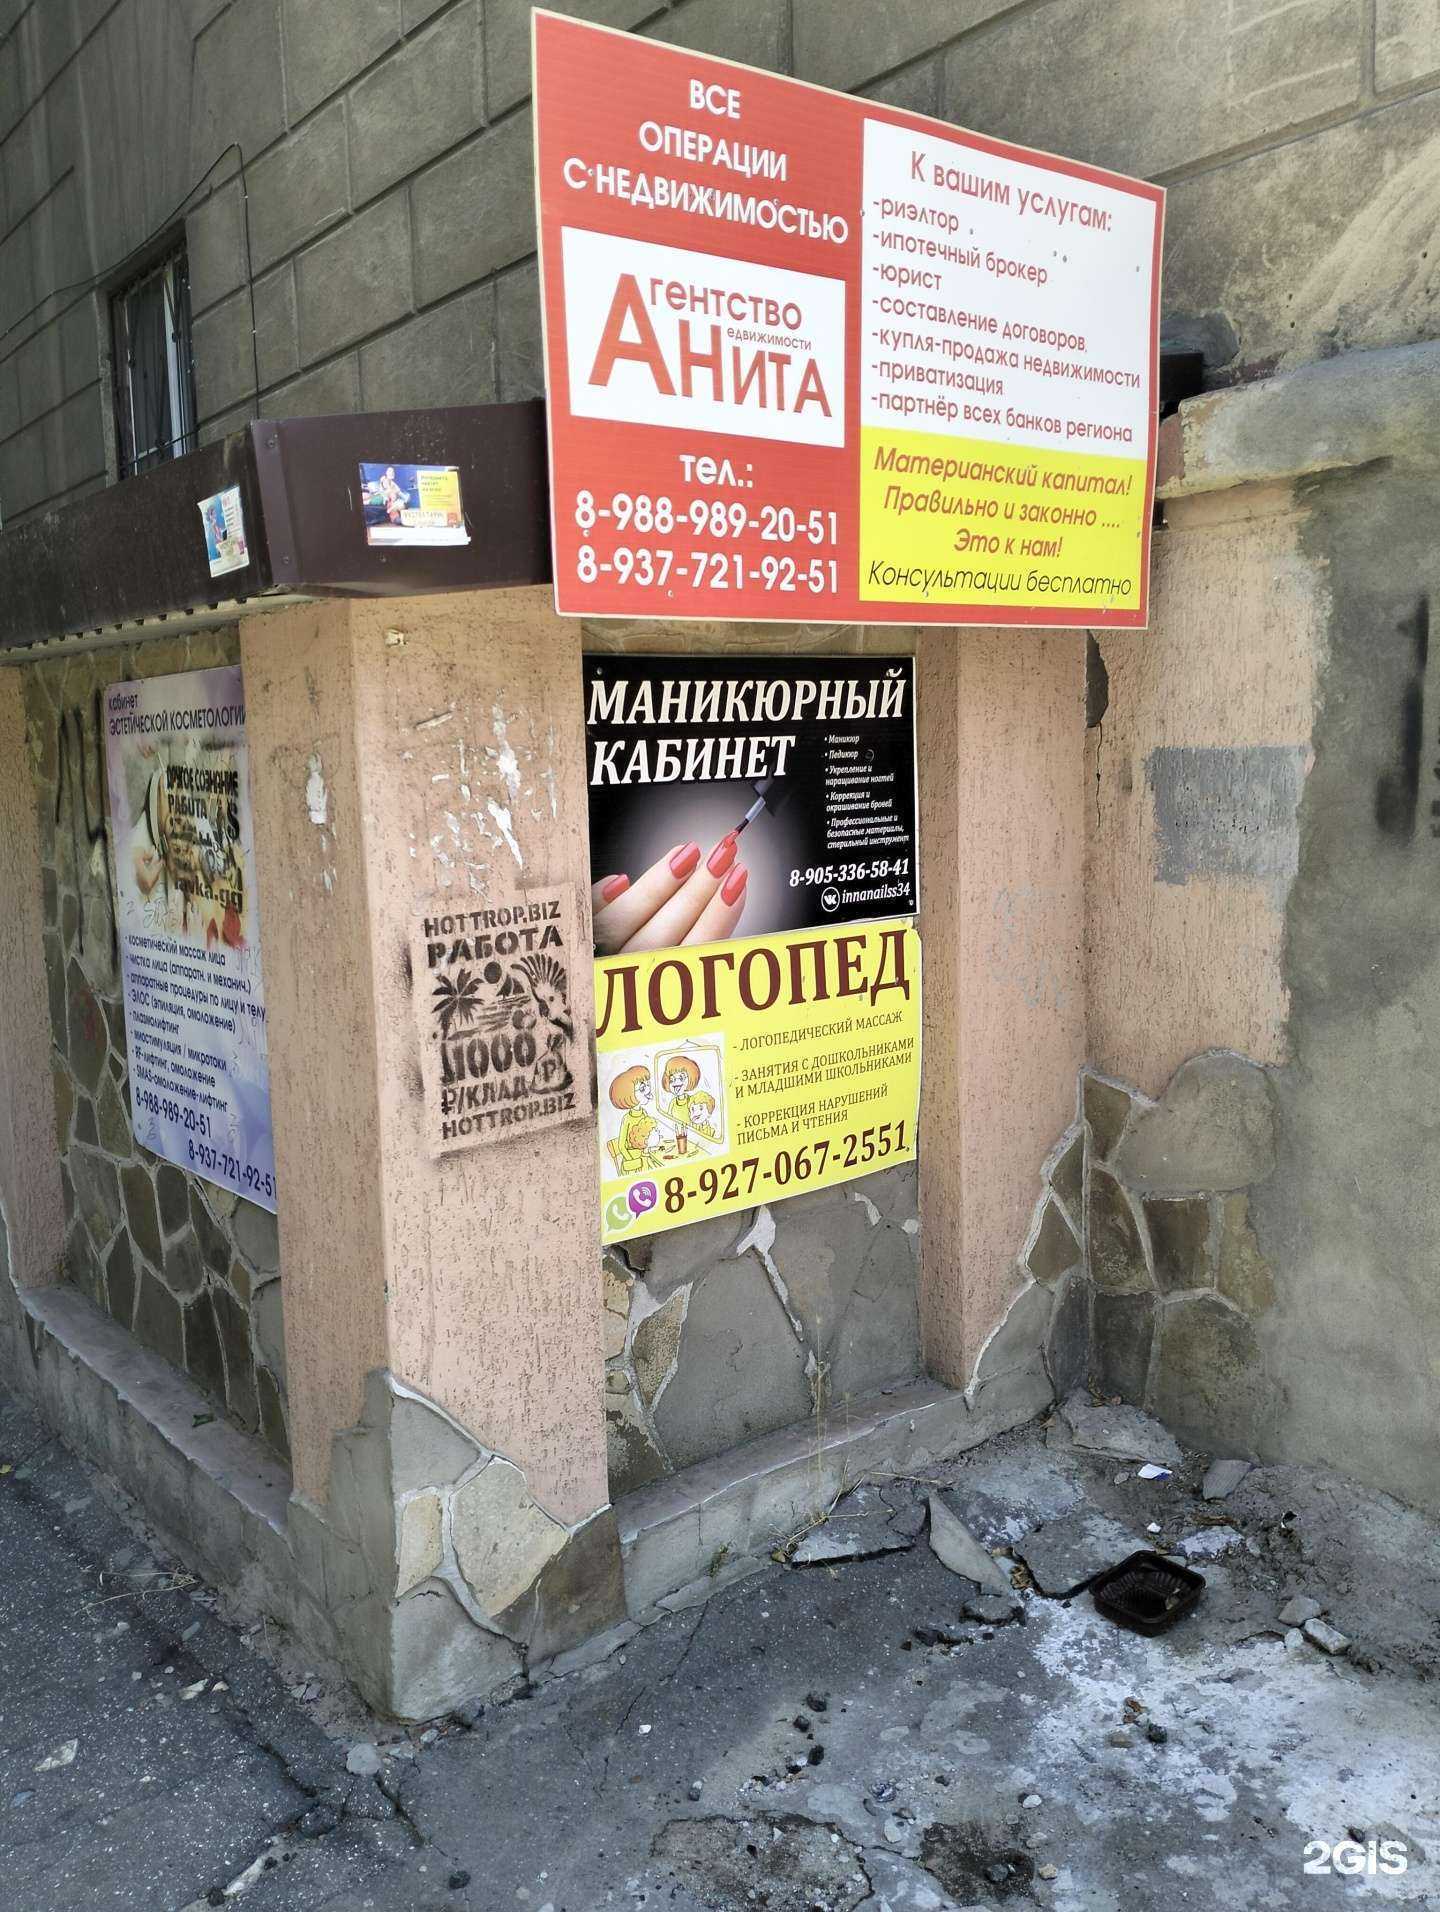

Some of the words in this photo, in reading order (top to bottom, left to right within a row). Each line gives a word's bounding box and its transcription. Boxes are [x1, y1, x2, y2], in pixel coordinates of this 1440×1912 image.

[689, 79, 741, 119] ВСЕ
[639, 121, 787, 181] ОПЕРАЦИИ
[563, 157, 588, 189] С
[596, 164, 848, 244] НЕДВИЖИМОСТЬЮ
[911, 150, 926, 182] К
[933, 163, 1010, 206] вашим
[1017, 187, 1112, 232] услугам:
[873, 198, 959, 235] -риэлтор
[873, 230, 981, 269] -ипотечный
[985, 252, 1048, 287] брокер
[873, 263, 942, 290] -юрист
[872, 296, 998, 334] -составление
[588, 273, 832, 417] АНИТА
[872, 360, 1004, 396] -приватизация
[1023, 353, 1141, 389] недвижимости
[963, 404, 1002, 425] всех
[1006, 408, 1062, 434] банков
[1066, 420, 1133, 442] региона
[679, 454, 753, 488] тел.:
[873, 446, 1038, 488] Материанский
[1042, 470, 1133, 496] капитал!
[575, 489, 837, 545] 8-988-989-20-51
[883, 485, 998, 518] Правильно
[1003, 502, 1015, 520] и
[1018, 504, 1097, 528] законно
[954, 528, 1000, 554] Это
[1005, 539, 1016, 555] к
[1020, 537, 1063, 558] нам!
[577, 544, 837, 594] 8-937-721-92-51
[868, 560, 1022, 593] Консультации
[1026, 570, 1132, 596] бесплатно
[108, 693, 139, 710] кабинет
[587, 667, 906, 725] МАНИКЮРНЫЙ
[828, 734, 860, 745] Маникюр
[828, 749, 859, 760] Педикюр
[590, 735, 797, 786] КАБИНЕТ
[789, 857, 909, 887] 8-905-336-58-41
[841, 881, 911, 904] innanailss34
[423, 900, 561, 938] HOTTROP.BIZ
[128, 935, 178, 955] косметический
[178, 945, 207, 963] массаж
[207, 953, 226, 967] лица
[129, 954, 151, 969] чистка
[151, 959, 168, 973] лица
[427, 925, 564, 968] РАБОТА
[130, 973, 169, 993] аппаратные
[169, 983, 209, 1004] процедуры
[209, 994, 219, 1007] по
[220, 997, 239, 1015] лицу
[596, 929, 911, 1038] ЛОГОПЕД
[131, 988, 150, 1007] ЭЛОС
[186, 1007, 236, 1035] омоложение)
[132, 1010, 180, 1035] плазмолифтинг
[740, 1017, 853, 1052] ЛОГОПЕДИЧЕСКИЙ
[855, 1010, 903, 1031] МАССАЖ
[134, 1030, 182, 1056] миостимуляция
[187, 1047, 227, 1071] микротоки
[741, 1059, 799, 1083] ЗАНЯТИЯ
[801, 1058, 810, 1071] С
[811, 1037, 915, 1070] ДОШКОЛЬНИКАМИ
[170, 1061, 216, 1088] омоложение
[735, 1086, 744, 1099] И
[747, 1070, 823, 1098] МЛАДШИМИ
[826, 1052, 912, 1081] ШКОЛЬНИКАМИ
[135, 1086, 212, 1139] 8-988-989-20-51
[442, 1092, 576, 1140] HOTTROP.BIZ
[743, 1101, 816, 1129] КОРРЕКЦИЯ
[818, 1082, 888, 1112] НАРУШЕНИЙ
[737, 1126, 788, 1146] ПИСЬМА
[791, 1121, 800, 1134] И
[802, 1109, 848, 1131] ЧТЕНИЯ
[188, 1138, 277, 1200] 8-937-721-92-51
